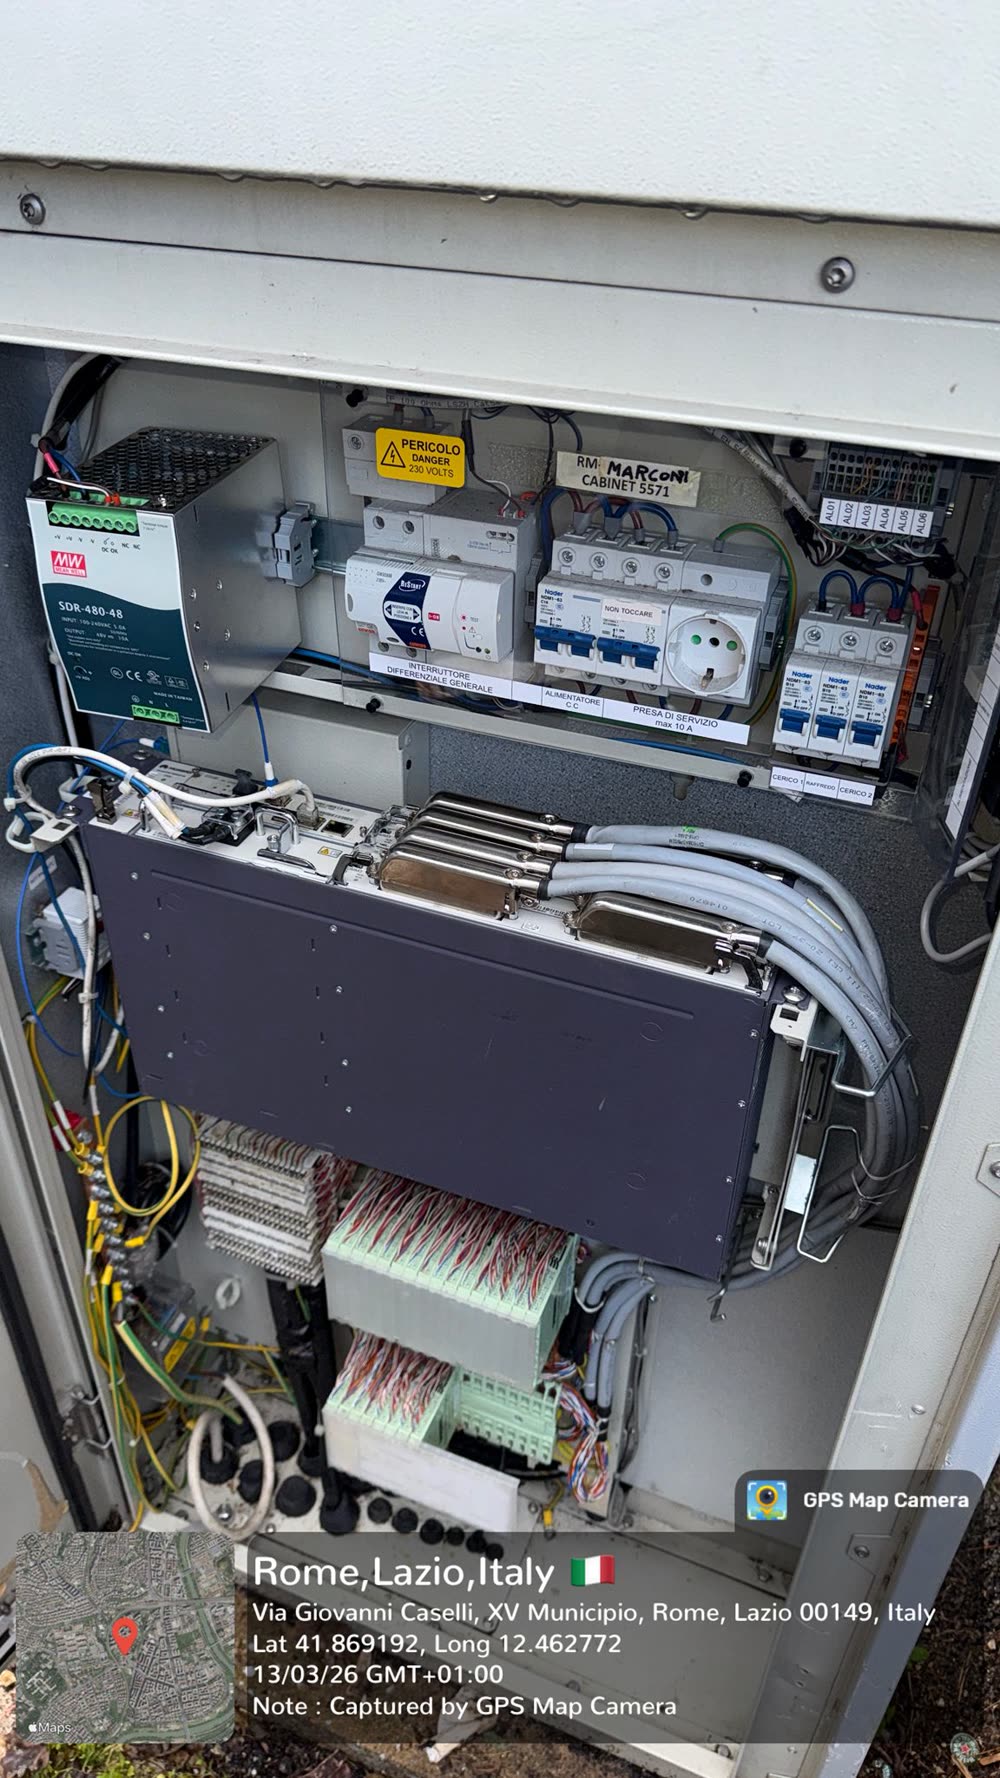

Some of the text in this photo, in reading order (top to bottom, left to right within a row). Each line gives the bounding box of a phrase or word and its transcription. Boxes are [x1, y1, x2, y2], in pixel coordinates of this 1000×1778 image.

[401, 438, 460, 456] PERICOLO
[412, 453, 450, 466] DANGER
[409, 464, 454, 478] 230 VOLTS
[582, 474, 670, 498] CABINET 5571
[825, 500, 836, 522] AL01
[842, 502, 854, 524] AL02
[861, 505, 872, 527] AL03
[879, 508, 890, 530] AL04
[897, 510, 909, 532] AL05
[916, 512, 928, 534] AL06
[54, 552, 83, 568] MW
[544, 588, 564, 597] Nader
[58, 600, 124, 619] SDR-480-48
[604, 604, 654, 618] NON TOCCARE
[408, 662, 470, 680] INTERRUTTORE
[792, 670, 813, 680] Nader
[387, 666, 493, 694] DIFFERENZIALE GENERALE
[828, 676, 850, 685] Nader
[864, 682, 886, 692] Nader
[544, 690, 600, 706] ALIMENTATORE
[632, 705, 718, 728] PRESA DI SERVIZIO
[655, 720, 694, 732] max 10 A
[772, 773, 800, 784] CERICO
[806, 780, 836, 791] RAFFREDO
[839, 786, 868, 797] CERICO
